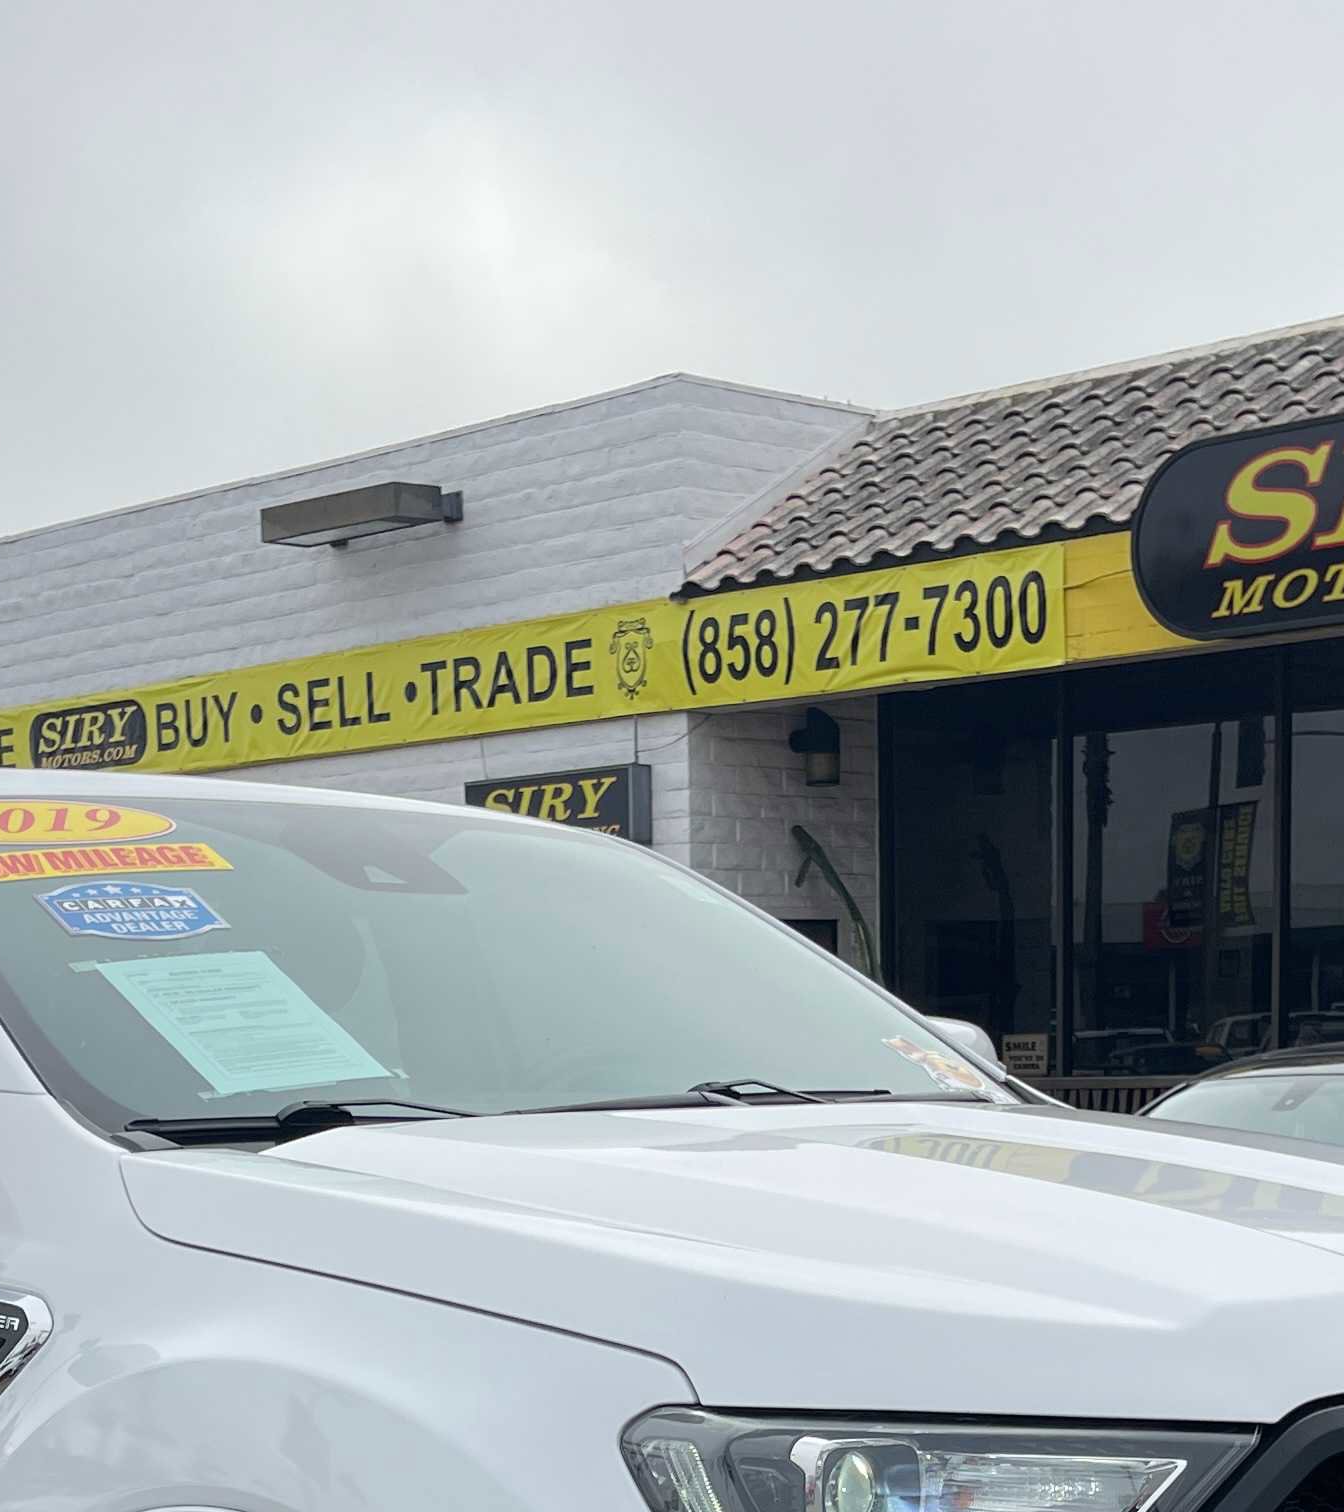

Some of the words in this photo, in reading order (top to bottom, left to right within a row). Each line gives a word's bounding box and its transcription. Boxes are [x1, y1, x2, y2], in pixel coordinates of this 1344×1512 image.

[682, 597, 796, 696] (858)
[814, 569, 1048, 672] 277-7300
[155, 692, 239, 753] BUY
[276, 671, 392, 736] SELL
[420, 637, 595, 716] TRADE
[37, 704, 138, 755] SIRY
[40, 743, 139, 769] MOTORS.COM
[483, 776, 618, 822] SIRY
[45, 843, 210, 874] MILEAGE
[61, 895, 199, 913] CARFAX
[82, 909, 199, 925] ADVANTAGE
[110, 920, 190, 934] DEALER
